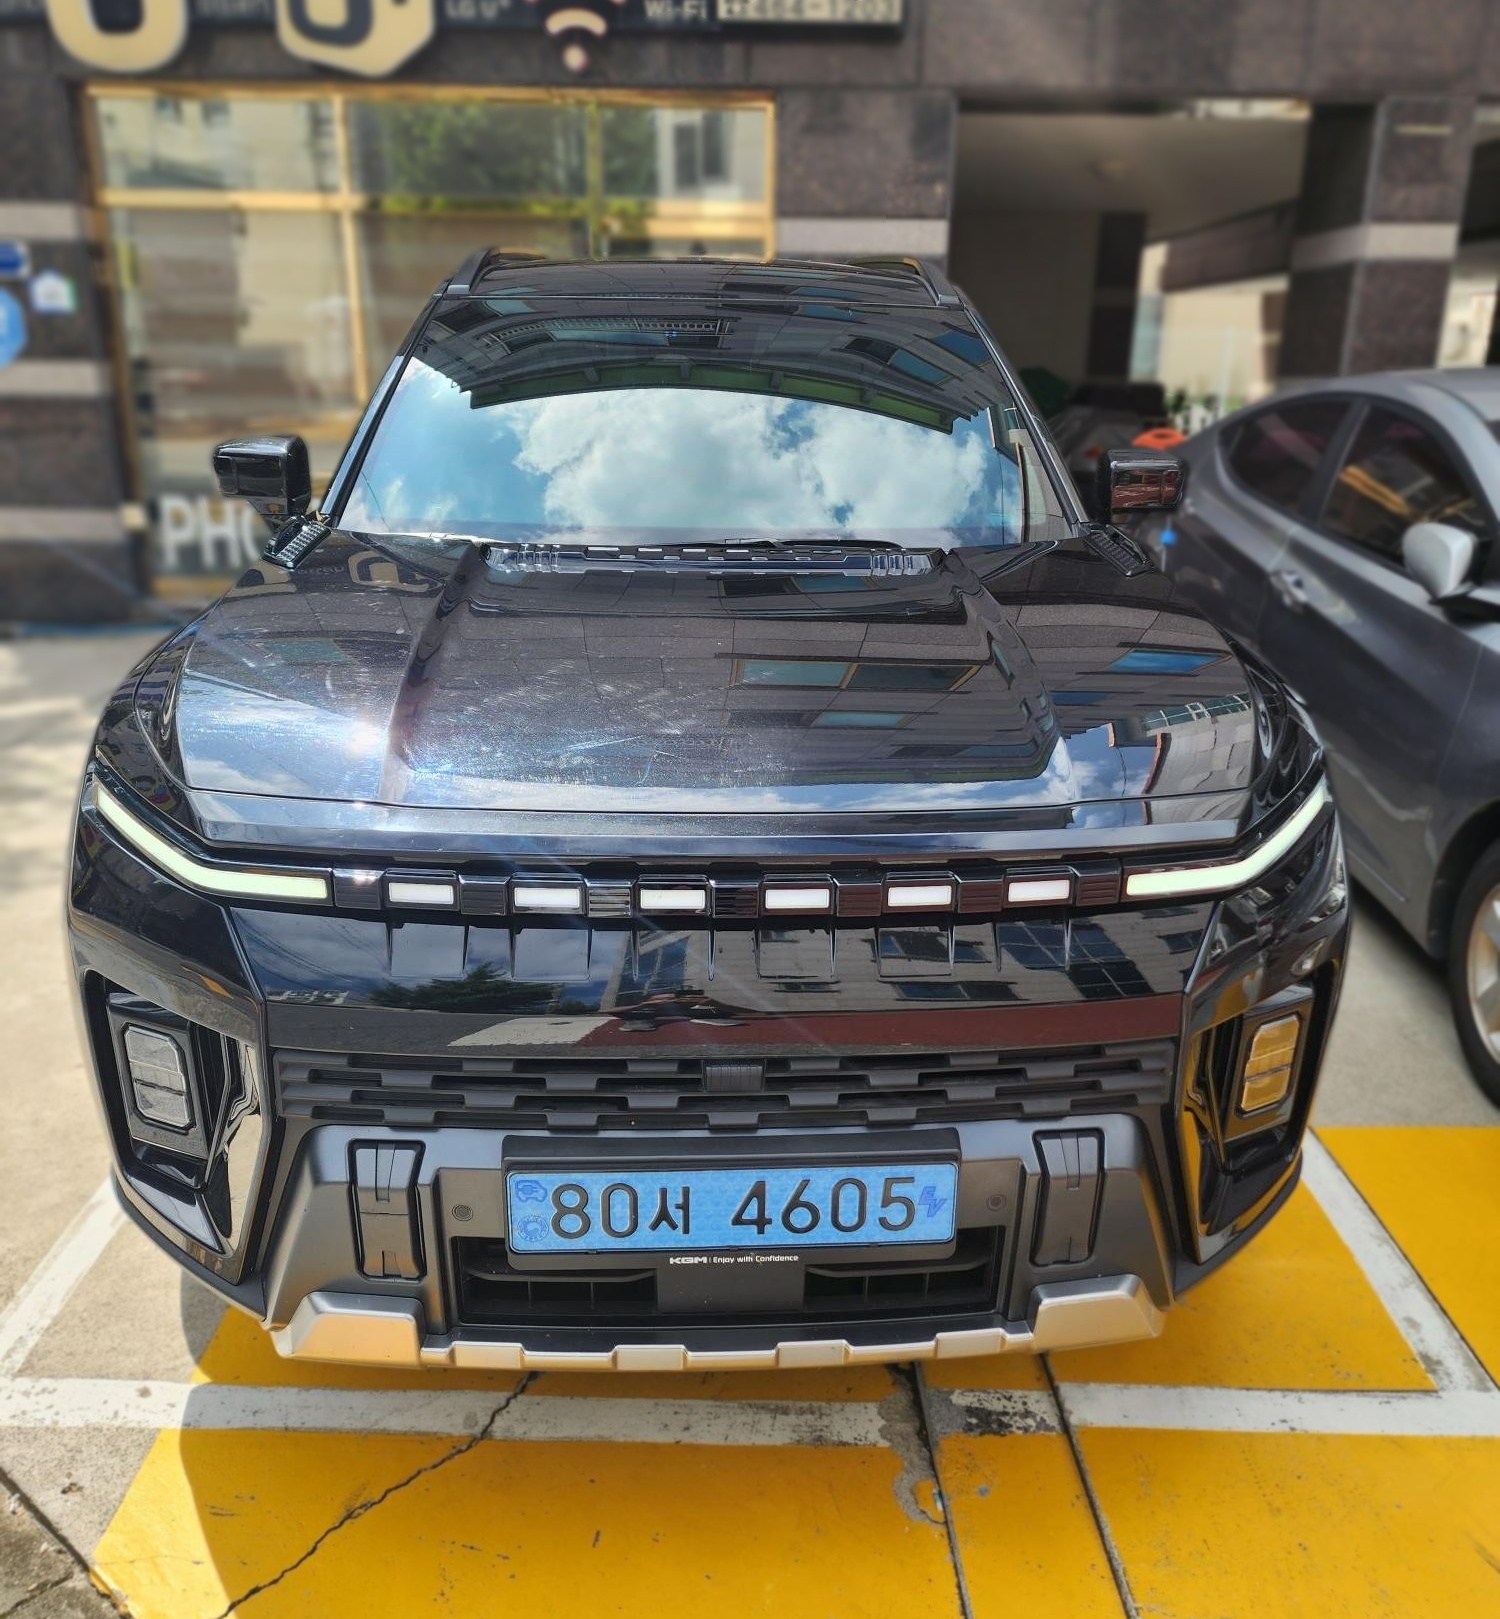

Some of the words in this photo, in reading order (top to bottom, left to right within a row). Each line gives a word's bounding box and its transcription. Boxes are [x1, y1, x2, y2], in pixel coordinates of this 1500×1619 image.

[645, 0, 709, 18] Wi-Fi
[551, 1183, 691, 1240] 80서
[730, 1176, 916, 1235] 4605
[669, 1256, 708, 1264] KGM
[713, 1256, 735, 1264] Enjoy
[737, 1255, 753, 1263] with
[755, 1254, 799, 1262] Confidence
